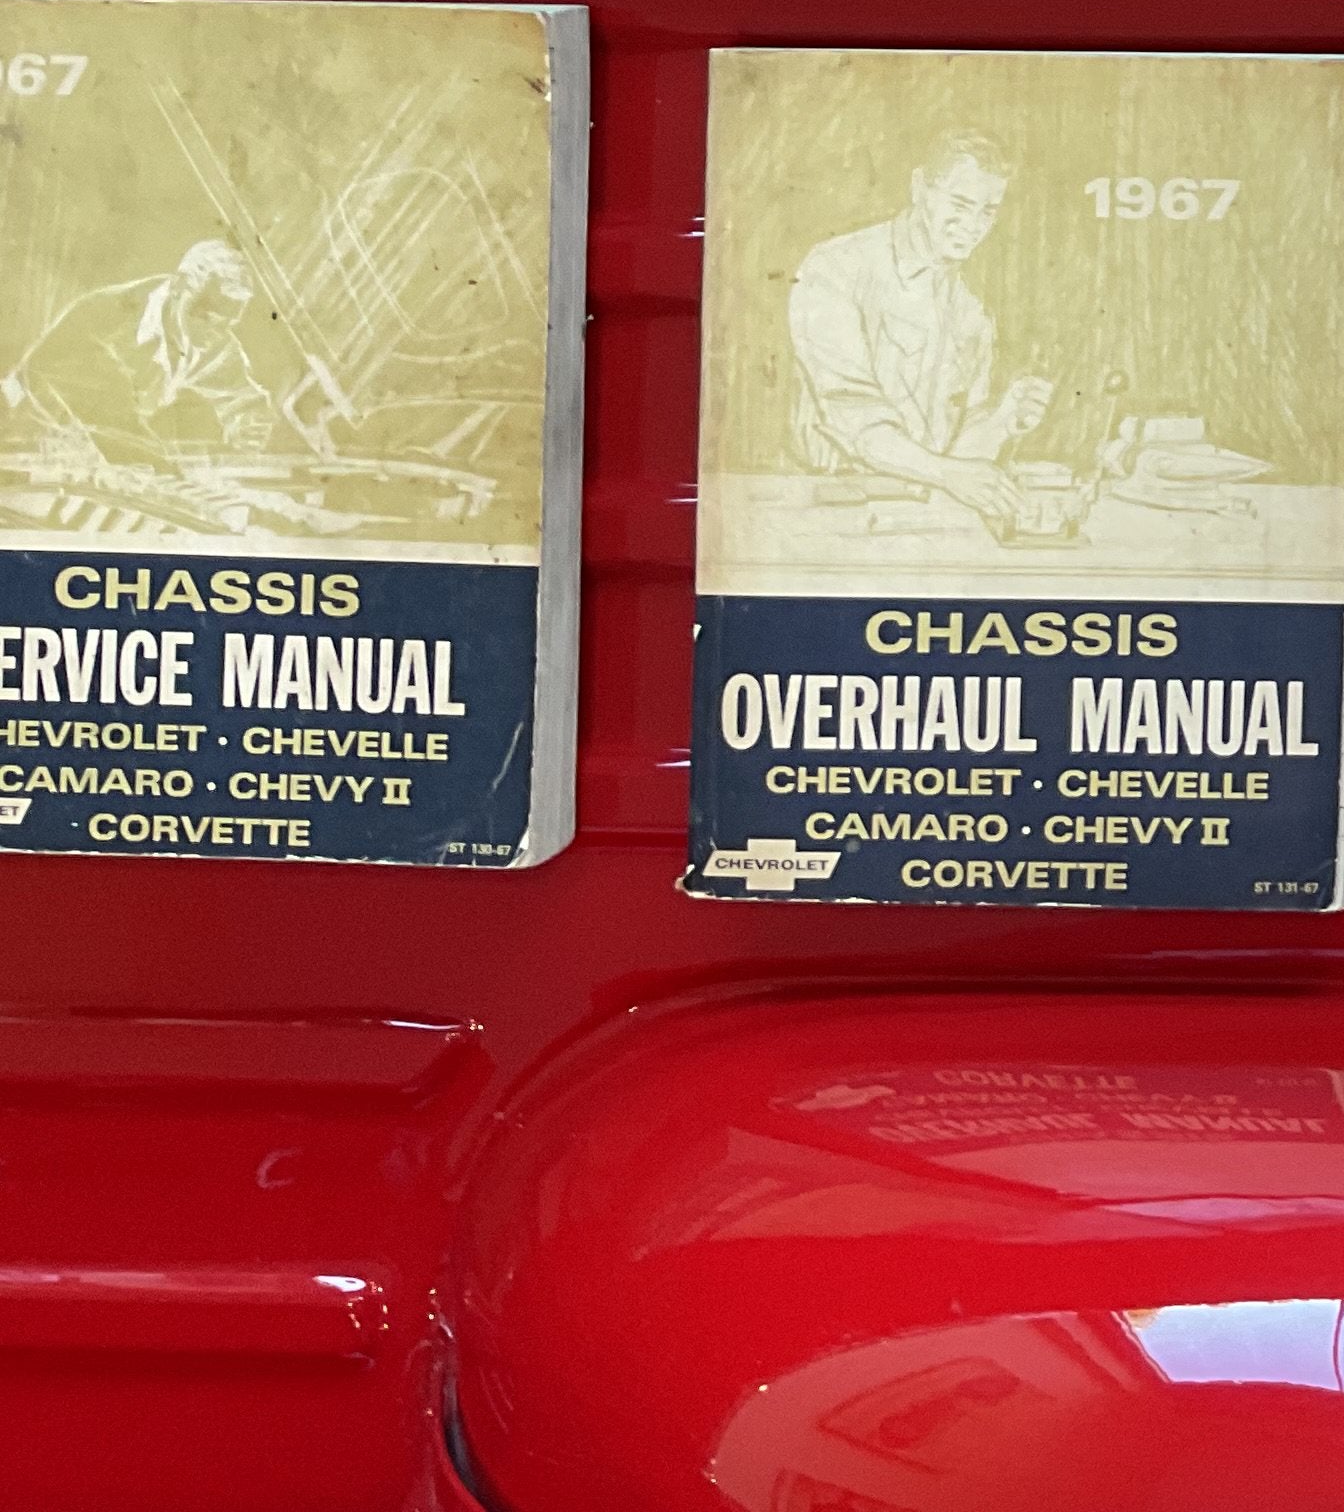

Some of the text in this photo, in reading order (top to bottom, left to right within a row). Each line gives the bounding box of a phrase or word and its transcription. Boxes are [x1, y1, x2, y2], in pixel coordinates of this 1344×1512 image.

[1084, 176, 1242, 221] 1967
[54, 565, 361, 618] CHASSIS
[865, 610, 1178, 658] CHASSIS
[222, 633, 466, 716] MANUAL
[720, 673, 1320, 756] OVERHAUL MANUAL
[243, 727, 450, 762] CHEVELLE
[0, 765, 194, 797] CAMARO
[229, 772, 375, 805] CHEVY
[766, 766, 1269, 800] CHEVROLET CHEVELLE
[88, 813, 311, 847] CORVETTE
[805, 811, 1230, 846] CAMARO CHEVY II
[448, 843, 511, 856] ST 130-67
[714, 858, 829, 871] CHEVROLET
[902, 859, 1128, 890] CORVETTE
[1254, 882, 1319, 895] ST 131-67
